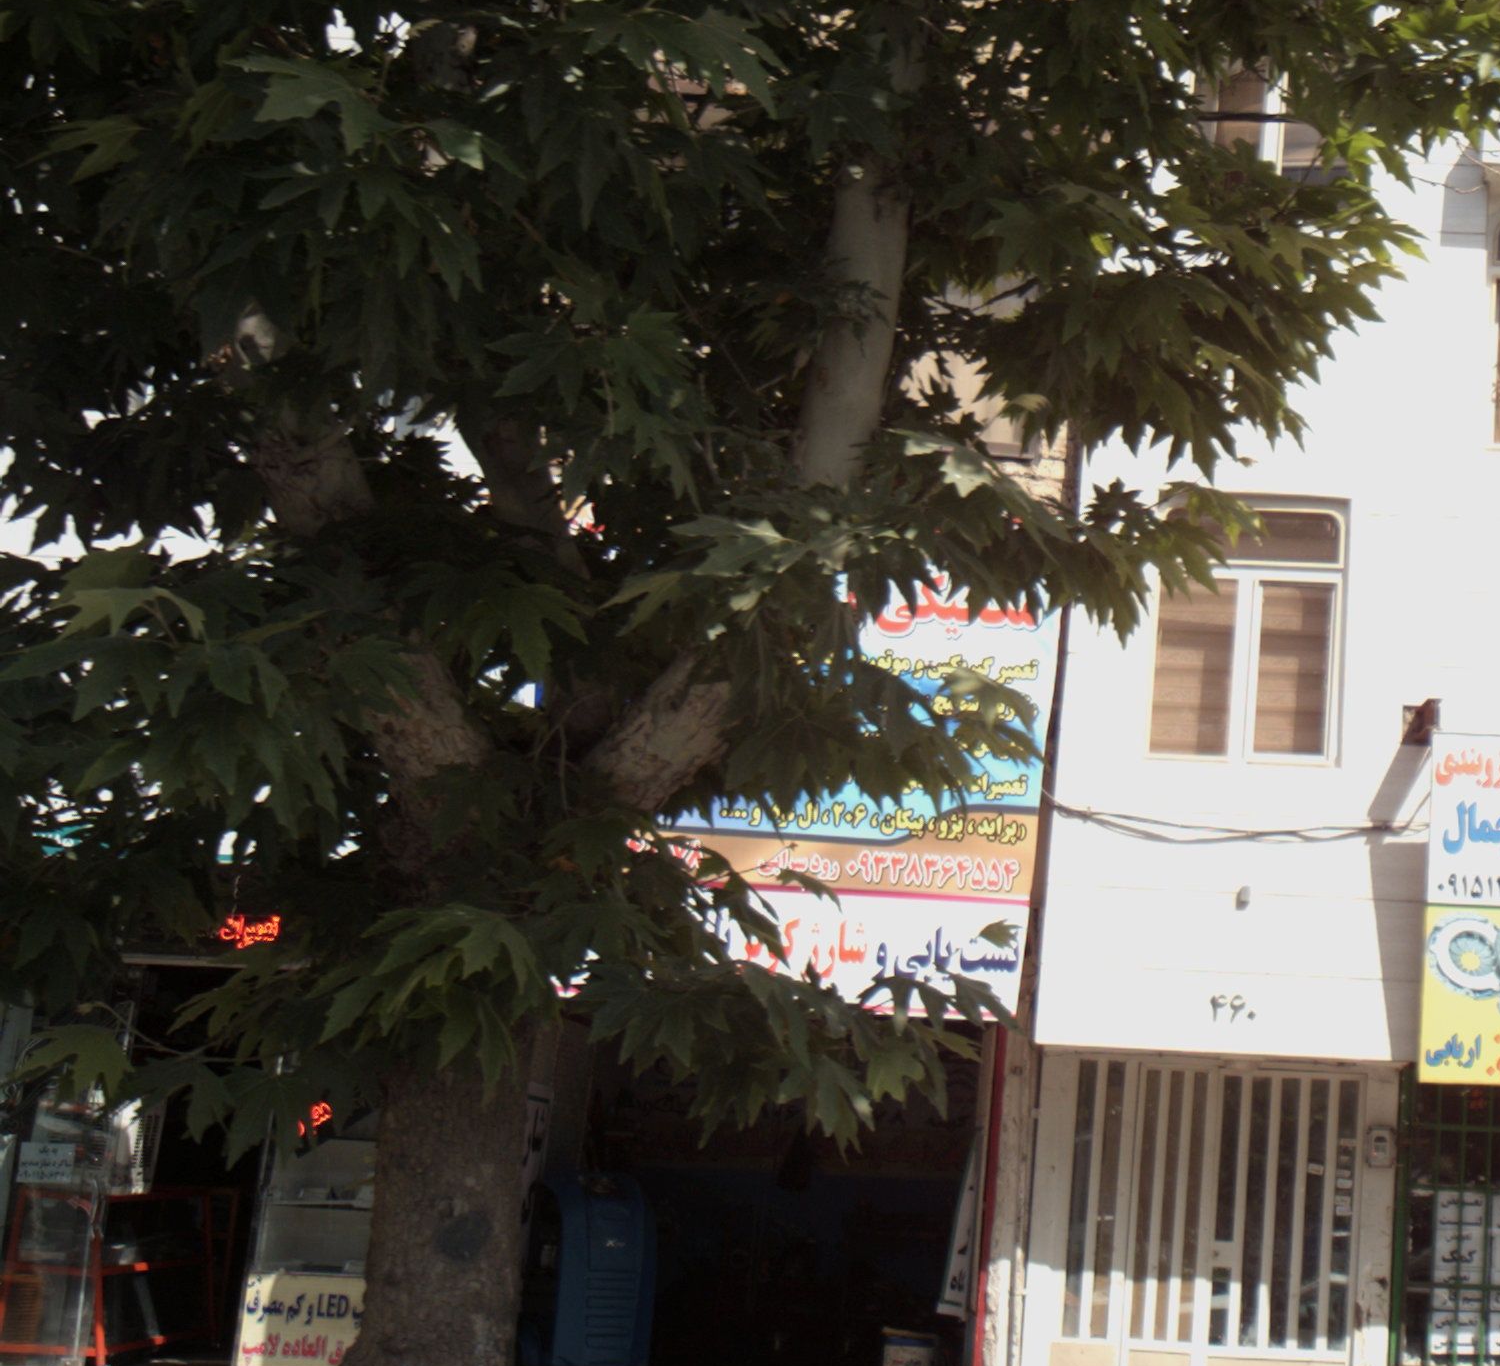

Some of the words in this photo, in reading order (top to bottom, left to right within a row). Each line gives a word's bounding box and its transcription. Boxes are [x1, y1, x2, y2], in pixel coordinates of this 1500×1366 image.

[873, 941, 888, 980] و
[1209, 994, 1256, 1024] ۴۶۰
[1424, 1032, 1482, 1069] اربابی
[246, 1289, 284, 1324] مصرف
[286, 1292, 307, 1325] کم
[304, 1303, 314, 1326] و
[316, 1293, 350, 1319] LED
[241, 1332, 281, 1366] لامپ
